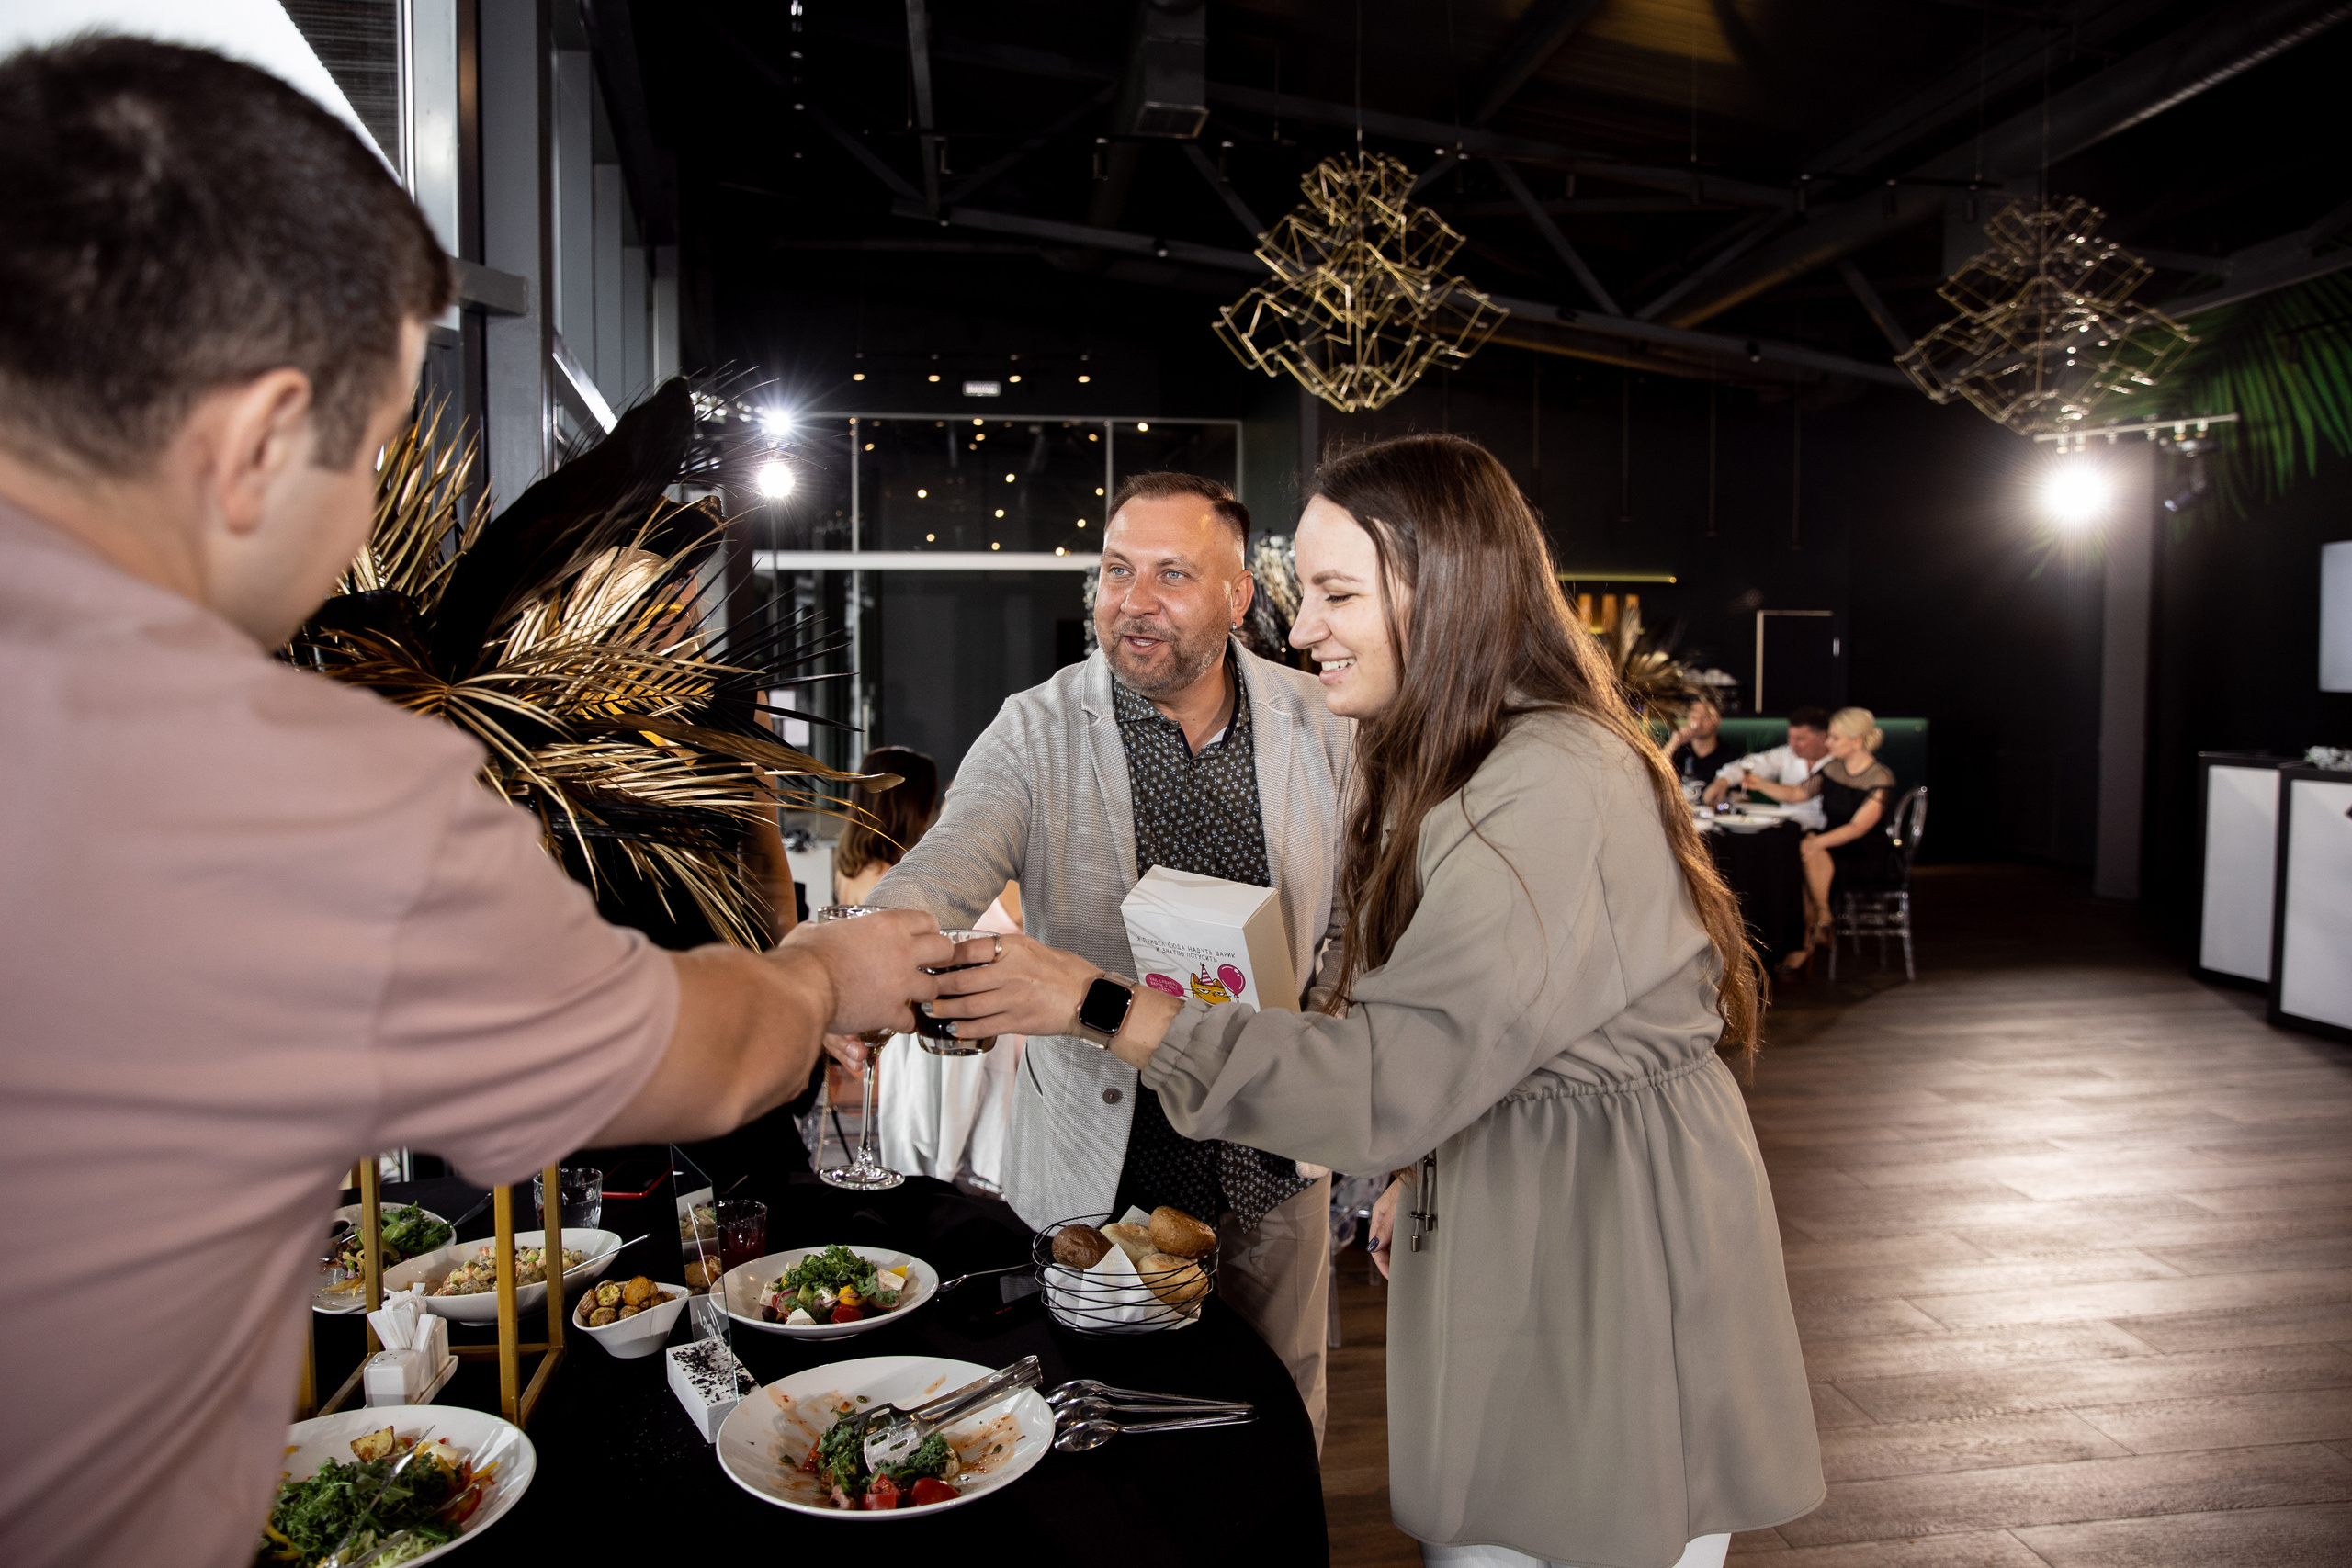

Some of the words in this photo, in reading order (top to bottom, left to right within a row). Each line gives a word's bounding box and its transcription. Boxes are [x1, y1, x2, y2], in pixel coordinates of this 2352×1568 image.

[1161, 948, 1184, 957] ЗНАТНО
[1186, 952, 1218, 963] ПОТУСИТЬ
[1167, 942, 1185, 951] СЮДА
[1187, 945, 1213, 955] НАДУТЬ
[1215, 950, 1236, 959] ШАРИК
